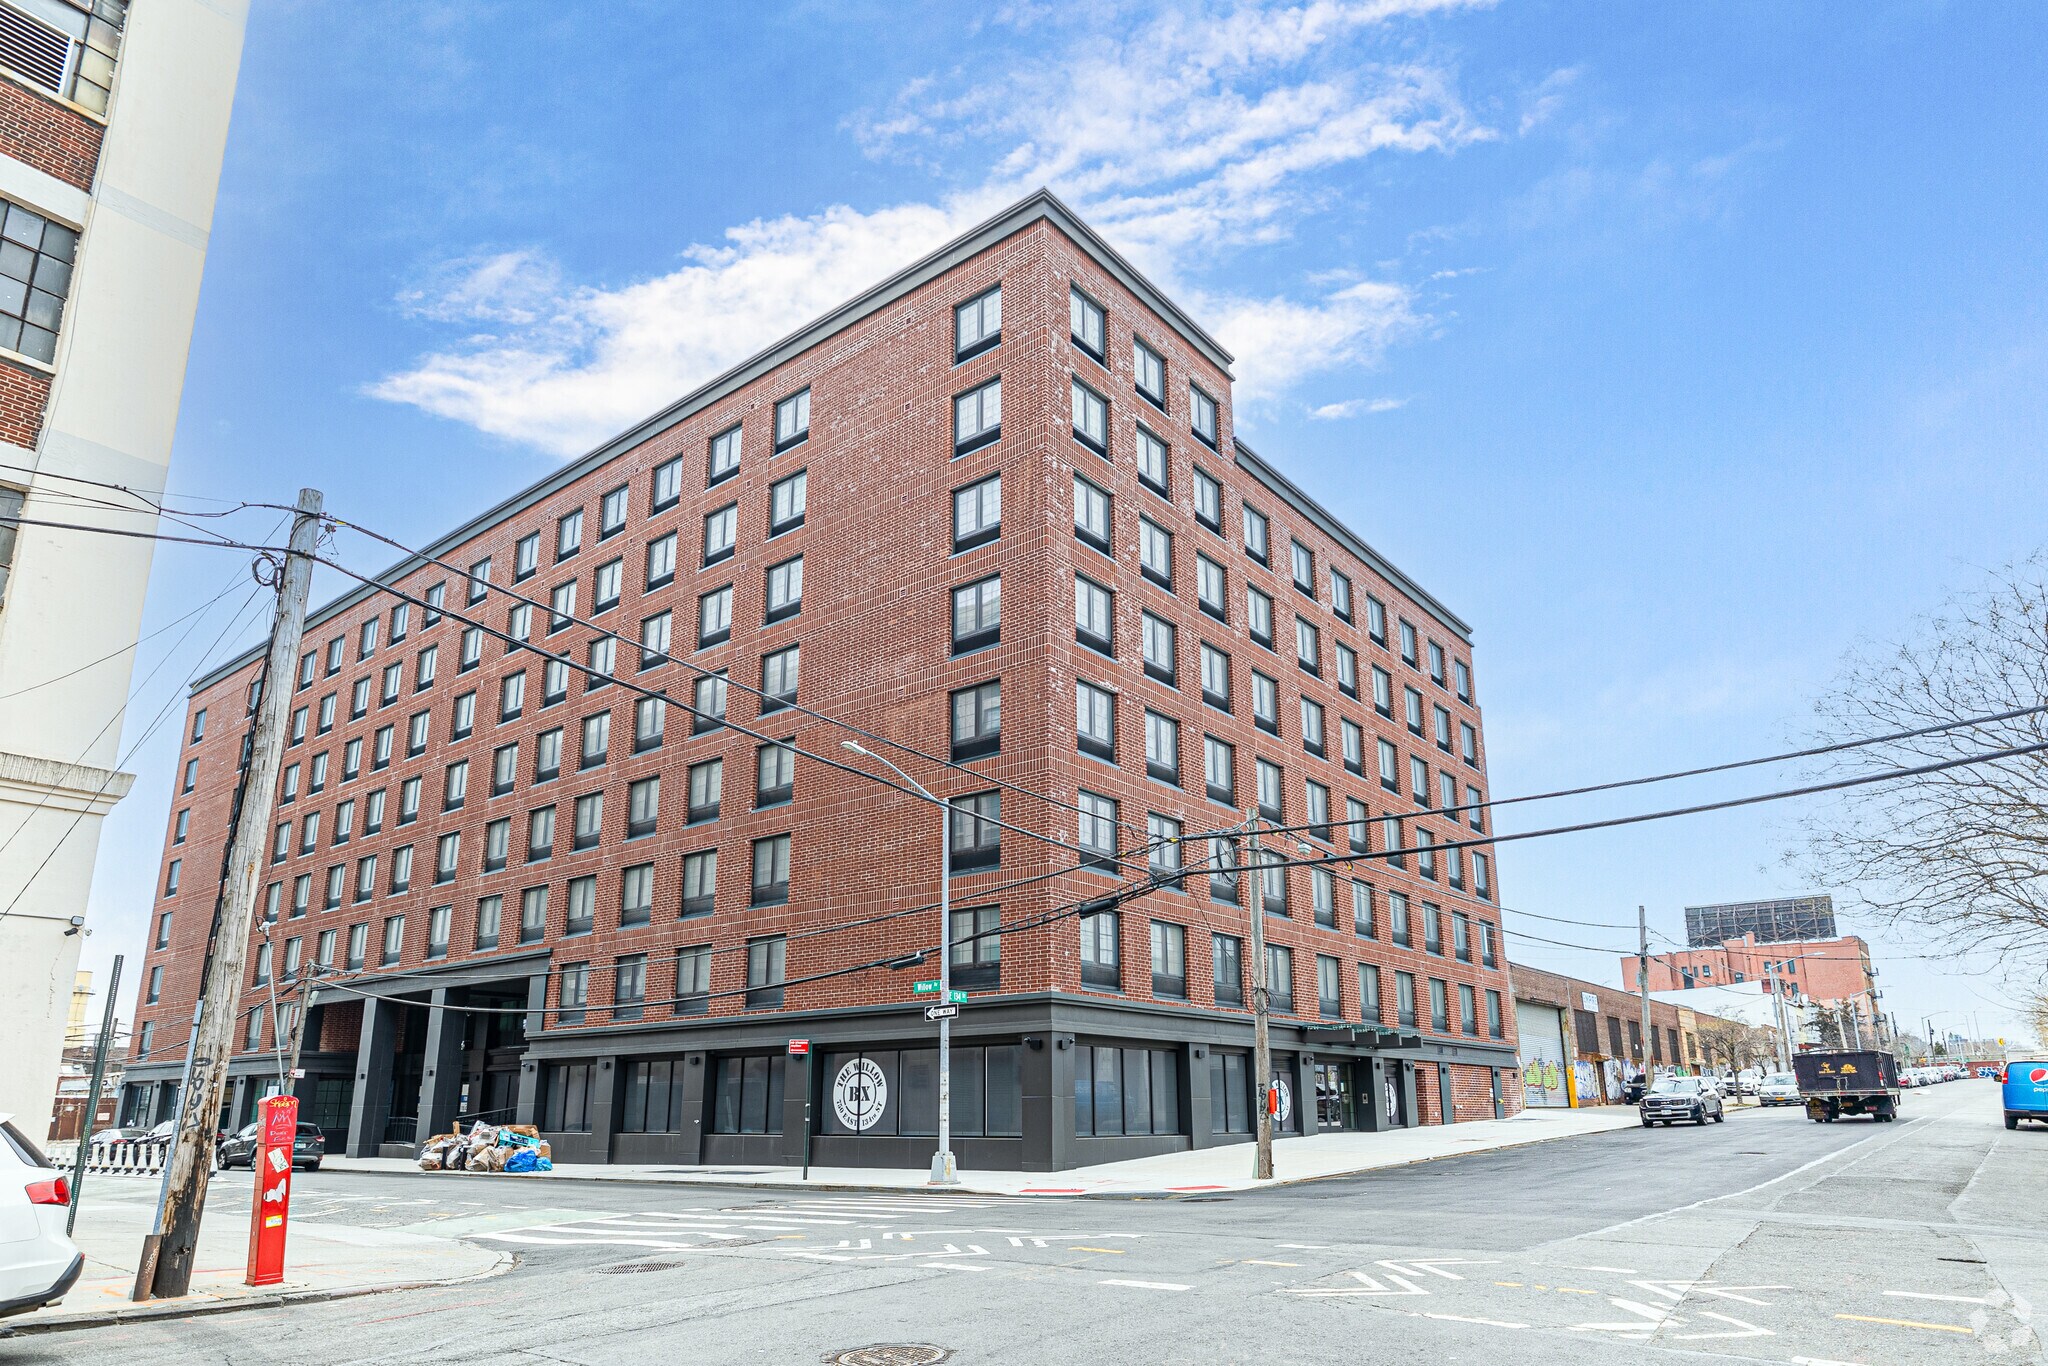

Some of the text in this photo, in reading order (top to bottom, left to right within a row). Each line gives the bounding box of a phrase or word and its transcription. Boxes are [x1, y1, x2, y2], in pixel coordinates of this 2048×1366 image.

[917, 983, 932, 991] Willow
[837, 1061, 884, 1088] THE WILLOW
[848, 1086, 870, 1102] BX
[842, 1112, 857, 1127] EAST
[875, 1101, 882, 1113] ST
